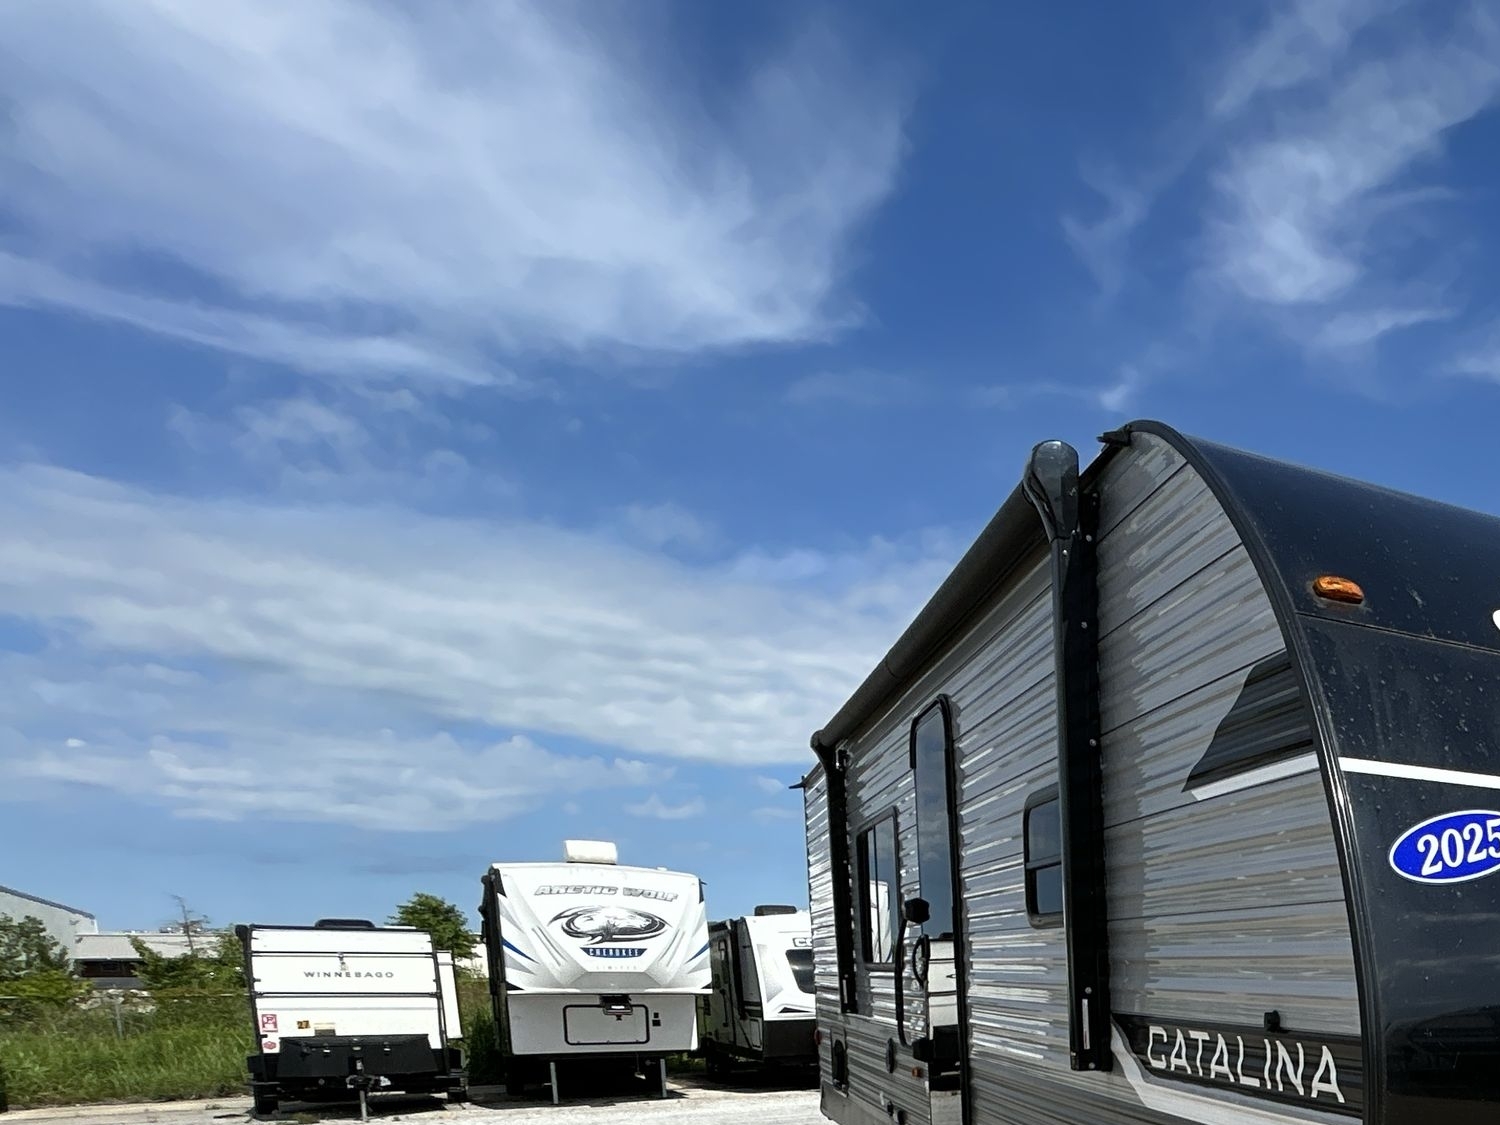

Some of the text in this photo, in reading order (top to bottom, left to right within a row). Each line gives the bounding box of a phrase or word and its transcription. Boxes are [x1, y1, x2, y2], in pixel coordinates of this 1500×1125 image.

[534, 884, 679, 902] ARCTIC WOLF
[589, 948, 640, 957] CHEROKEE
[304, 971, 395, 979] WINNEBAGO
[1146, 1025, 1346, 1104] CATALINA
